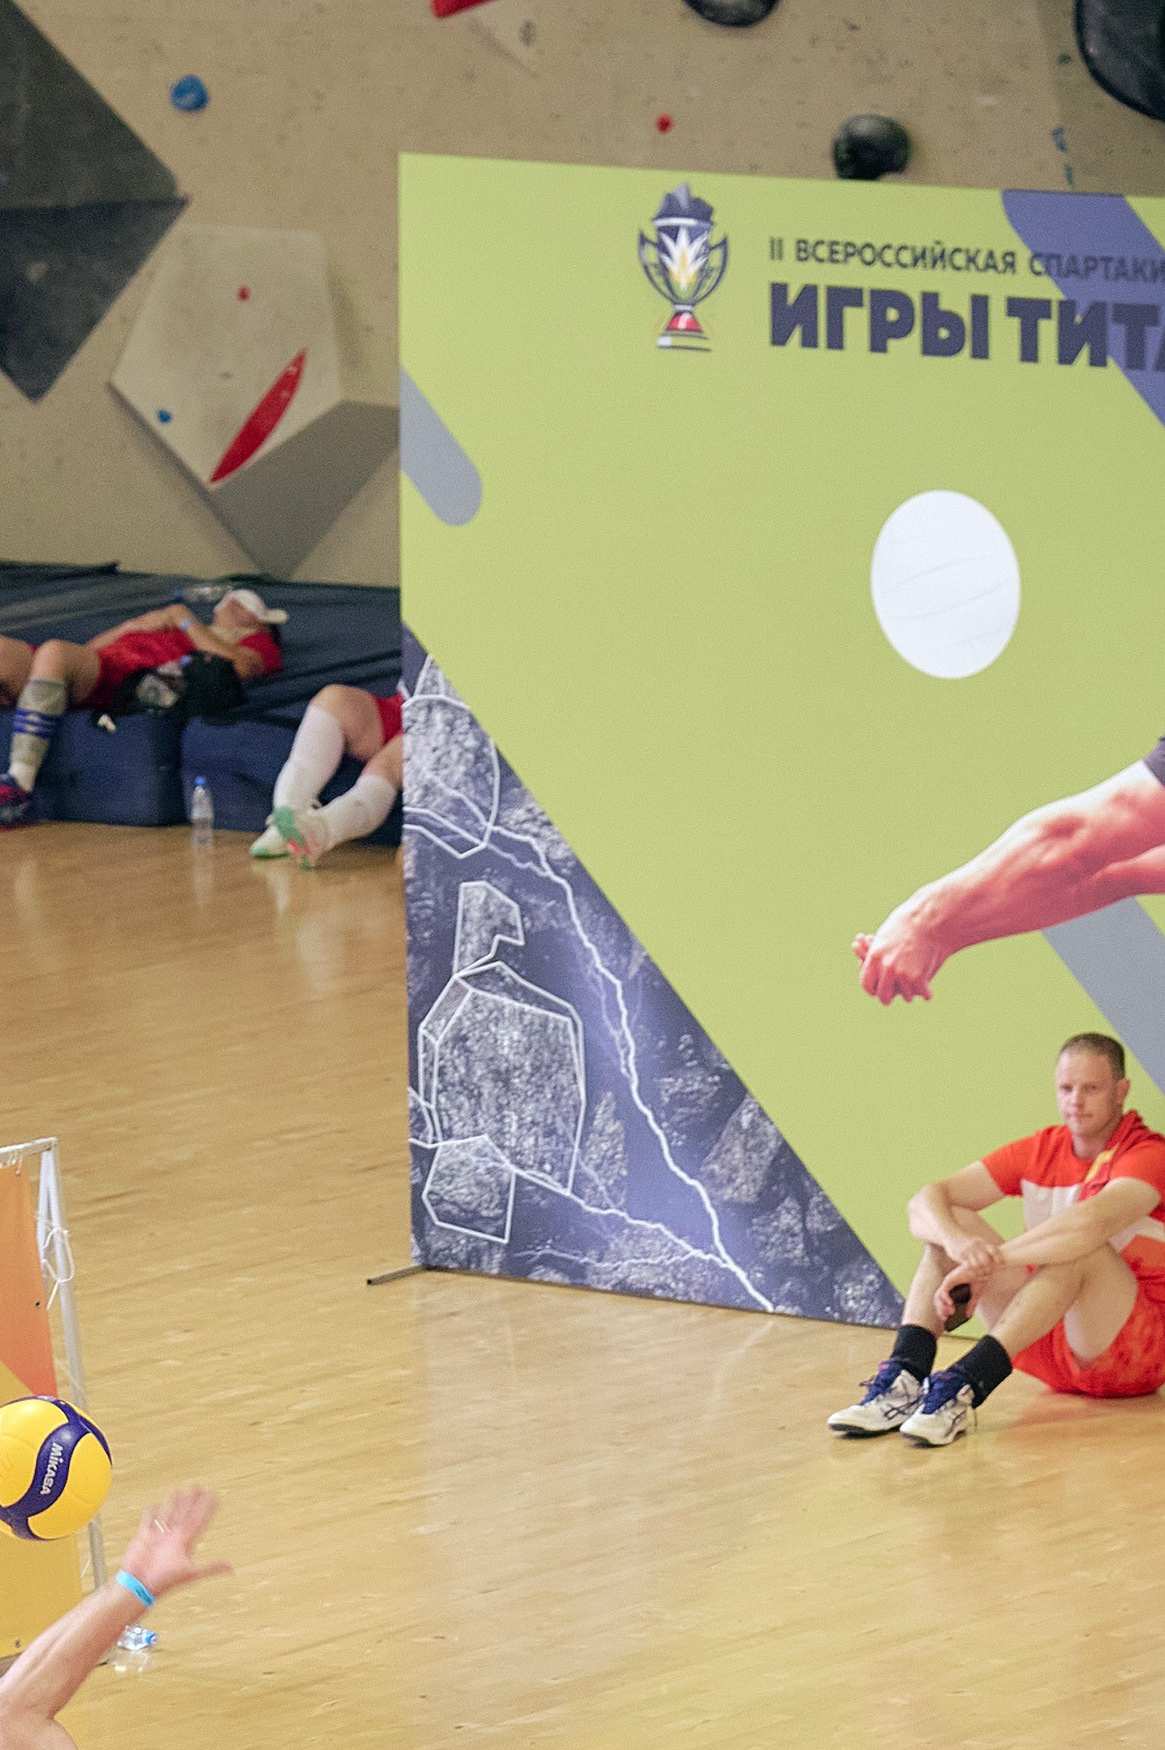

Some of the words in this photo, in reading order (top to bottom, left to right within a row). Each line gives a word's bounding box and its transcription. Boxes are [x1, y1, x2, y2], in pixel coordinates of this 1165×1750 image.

[770, 237, 783, 261] II
[796, 239, 1016, 275] ВСЕРОССИЙСКАЯ
[770, 283, 990, 360] ИГРЫ
[1007, 297, 1165, 373] ТИТ
